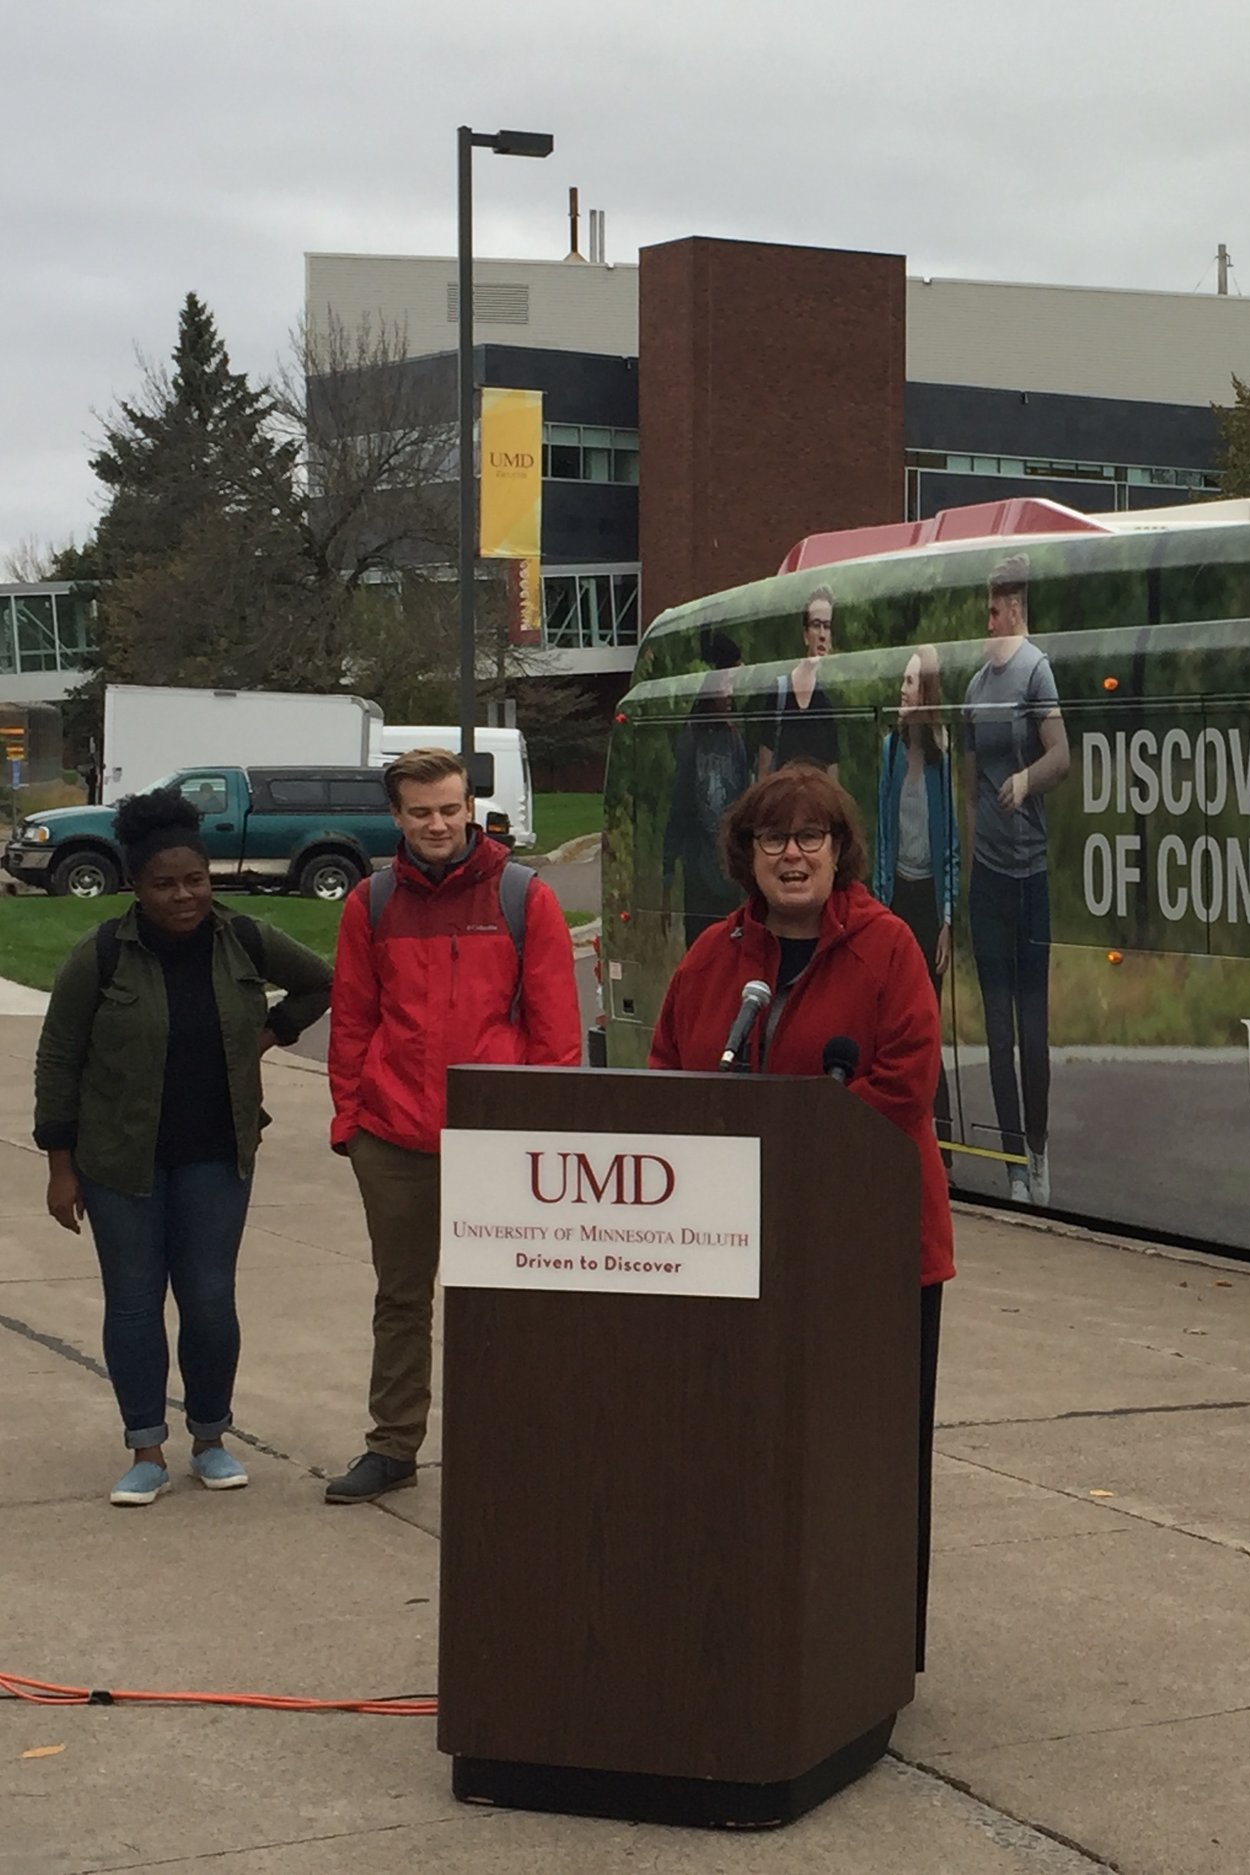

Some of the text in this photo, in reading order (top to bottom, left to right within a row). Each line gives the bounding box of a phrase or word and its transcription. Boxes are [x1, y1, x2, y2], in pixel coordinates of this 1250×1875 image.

[490, 452, 534, 468] UMD
[1083, 833, 1141, 917] OF
[526, 1152, 675, 1205] UMD
[453, 1221, 749, 1247] UNIVERSITY OF MINNESOTA DULUTH
[516, 1253, 682, 1273] Driven to Discover
